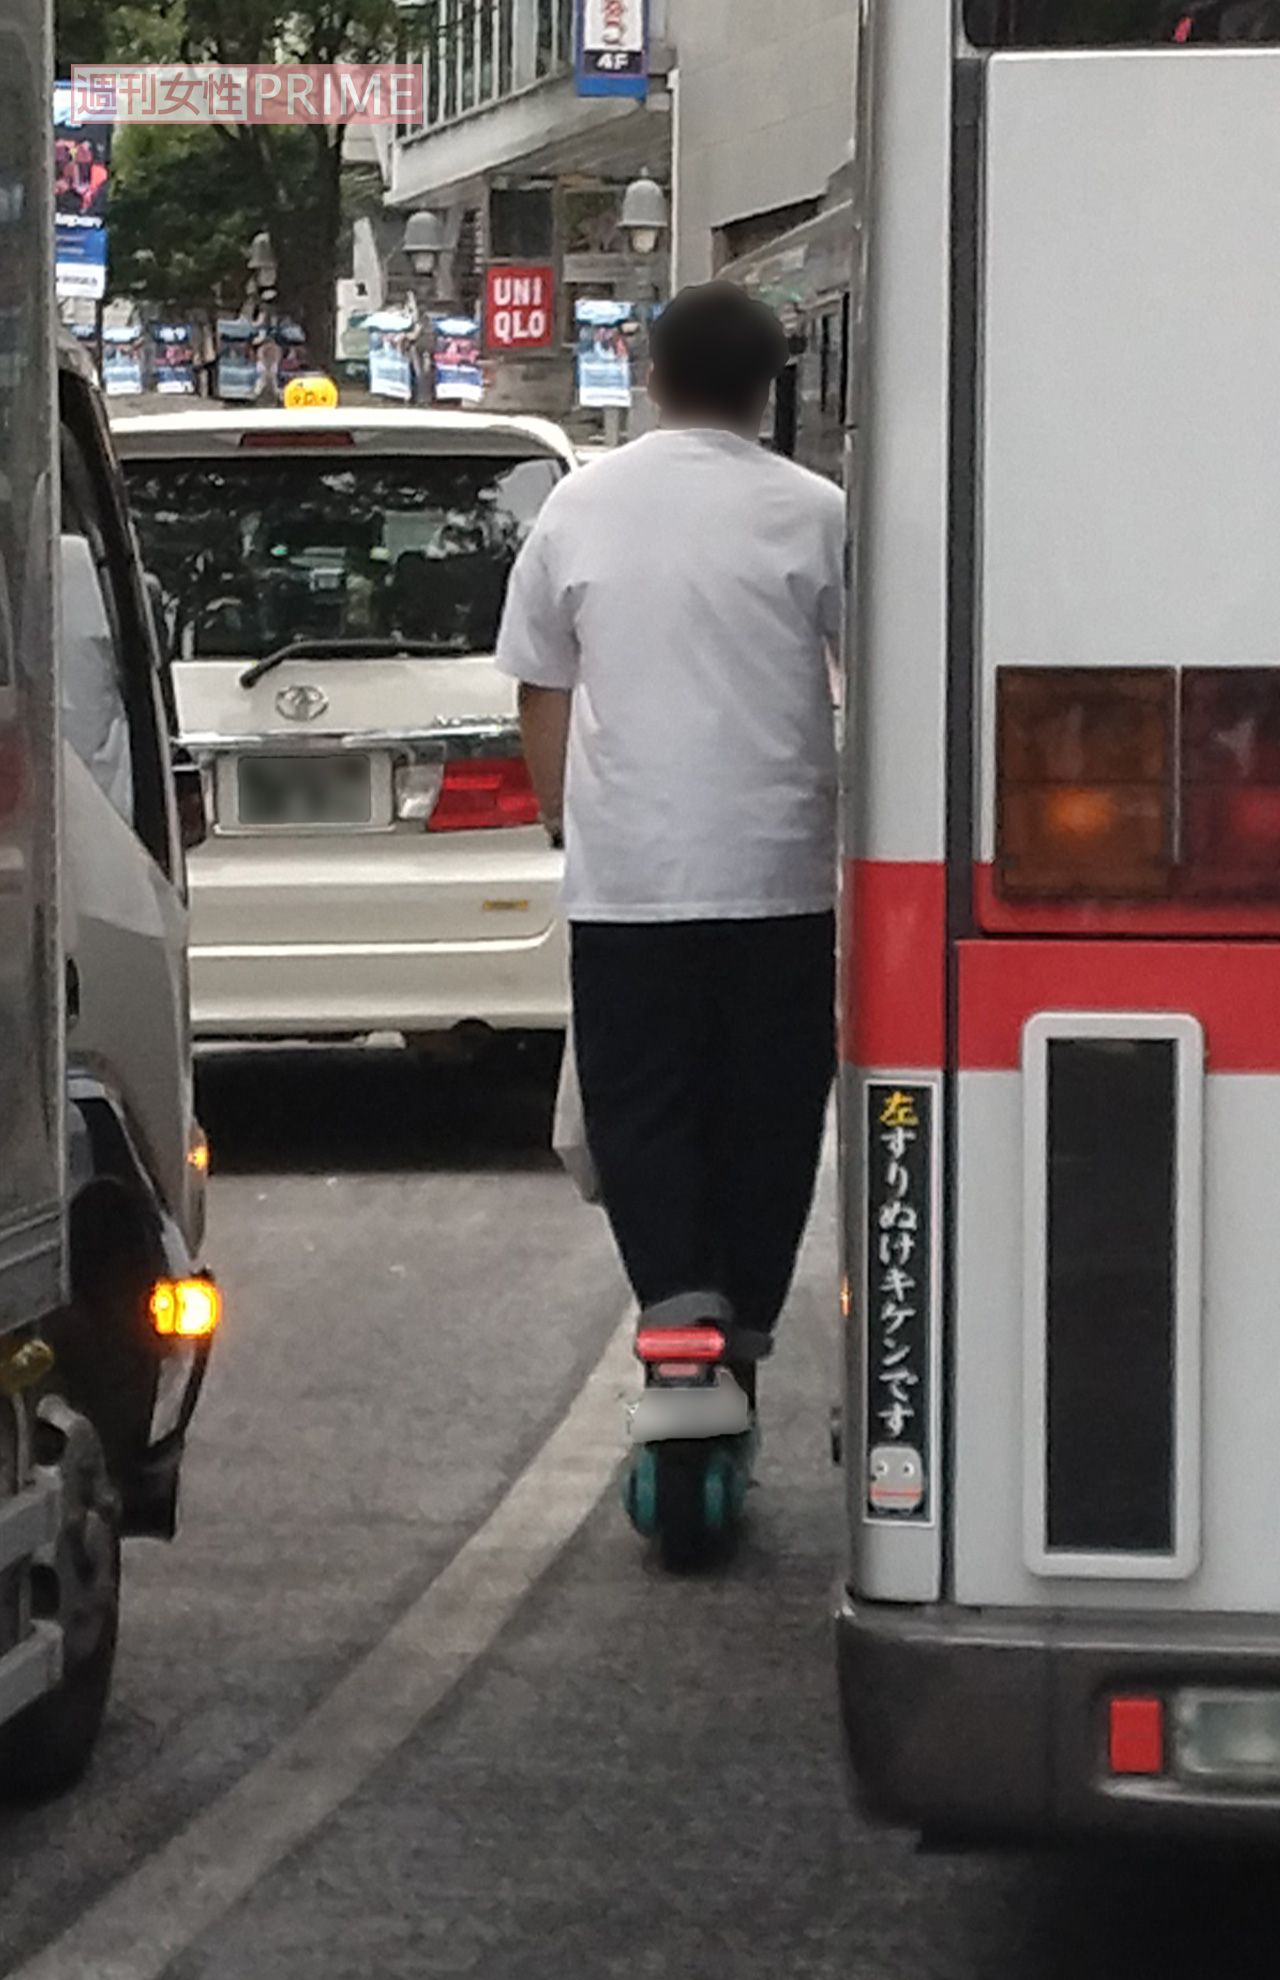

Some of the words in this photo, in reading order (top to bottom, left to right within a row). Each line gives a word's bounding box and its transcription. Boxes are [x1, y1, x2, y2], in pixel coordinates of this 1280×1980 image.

[596, 53, 629, 70] 4F
[493, 276, 542, 306] UNI
[494, 310, 546, 344] QLO
[877, 1090, 920, 1438] 左すりぬけキケンです
